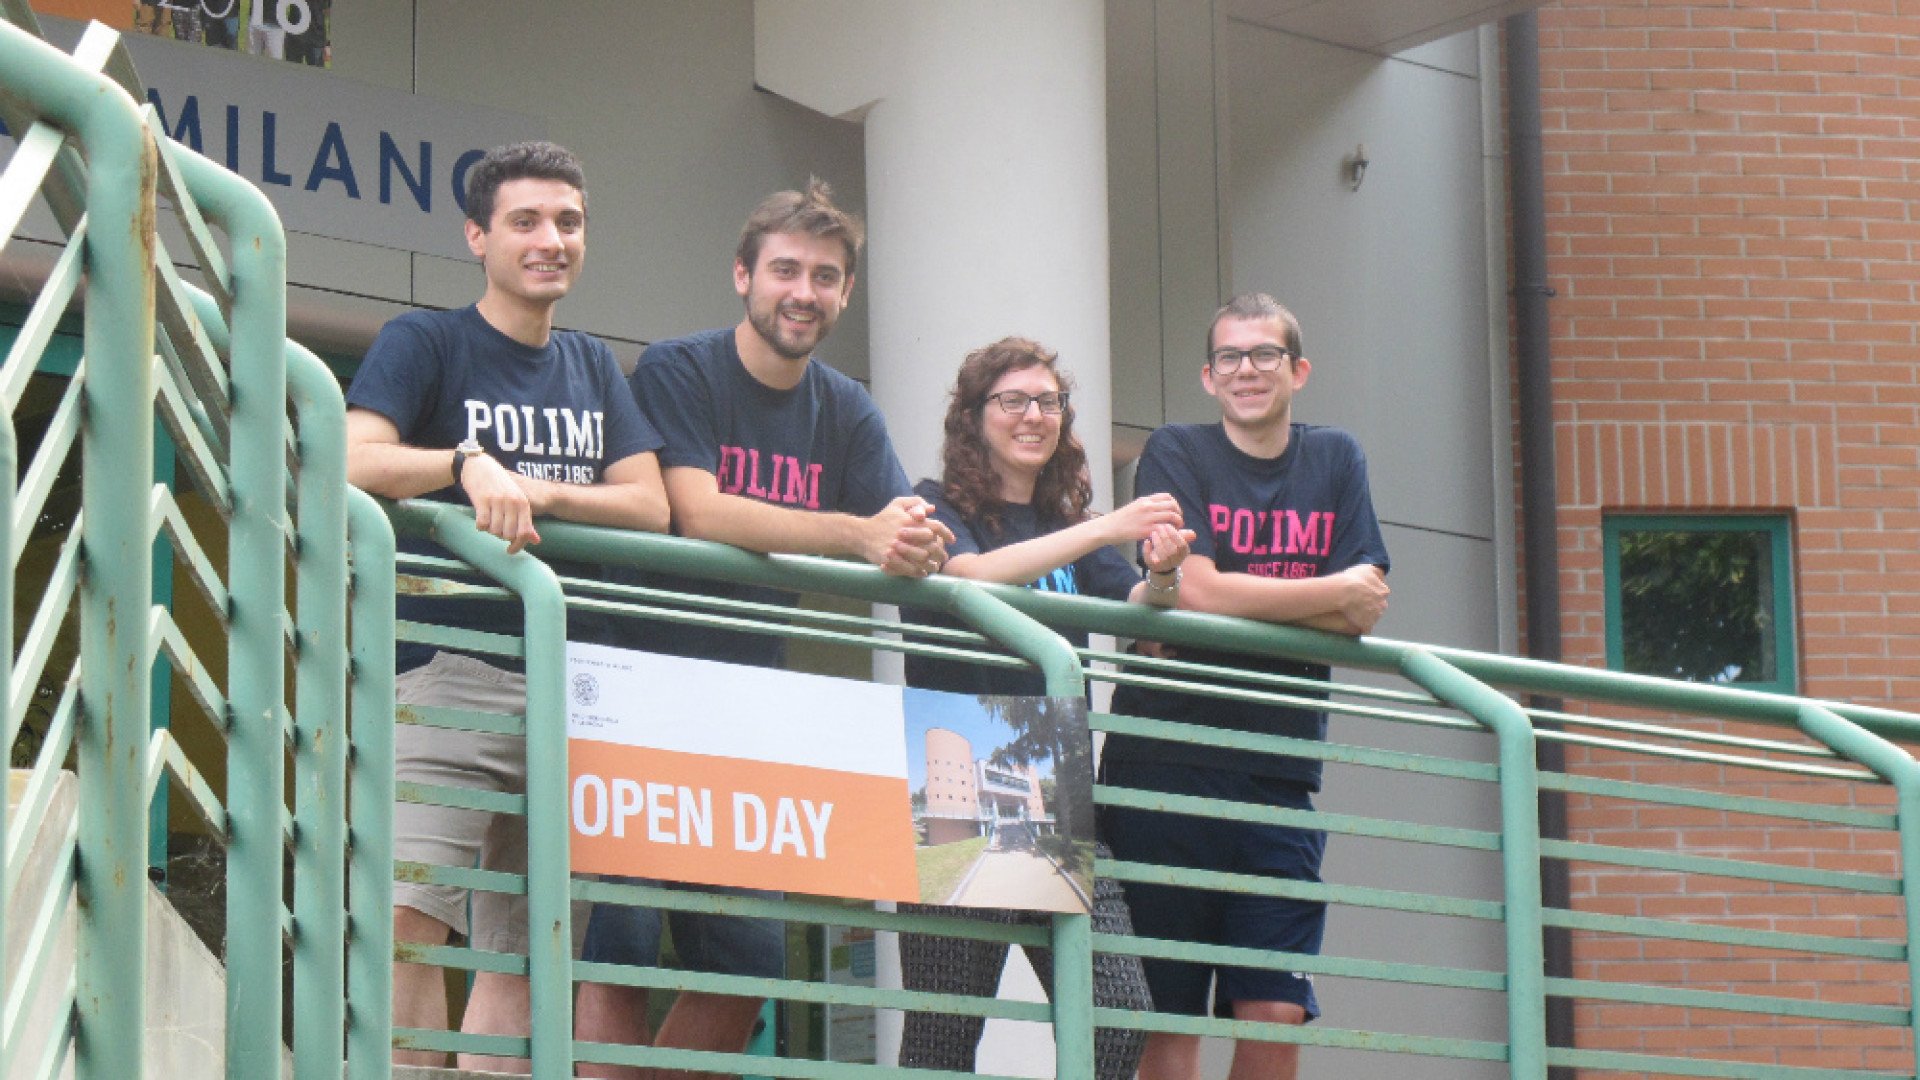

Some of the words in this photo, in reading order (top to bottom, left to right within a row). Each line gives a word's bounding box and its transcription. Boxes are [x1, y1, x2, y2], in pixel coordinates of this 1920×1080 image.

[464, 399, 604, 459] POLIMI
[516, 461, 562, 483] SINCE
[717, 445, 823, 509] OLIMI
[1208, 503, 1336, 557] POLIMI
[571, 774, 713, 848] OPEN
[732, 791, 834, 860] DAY
